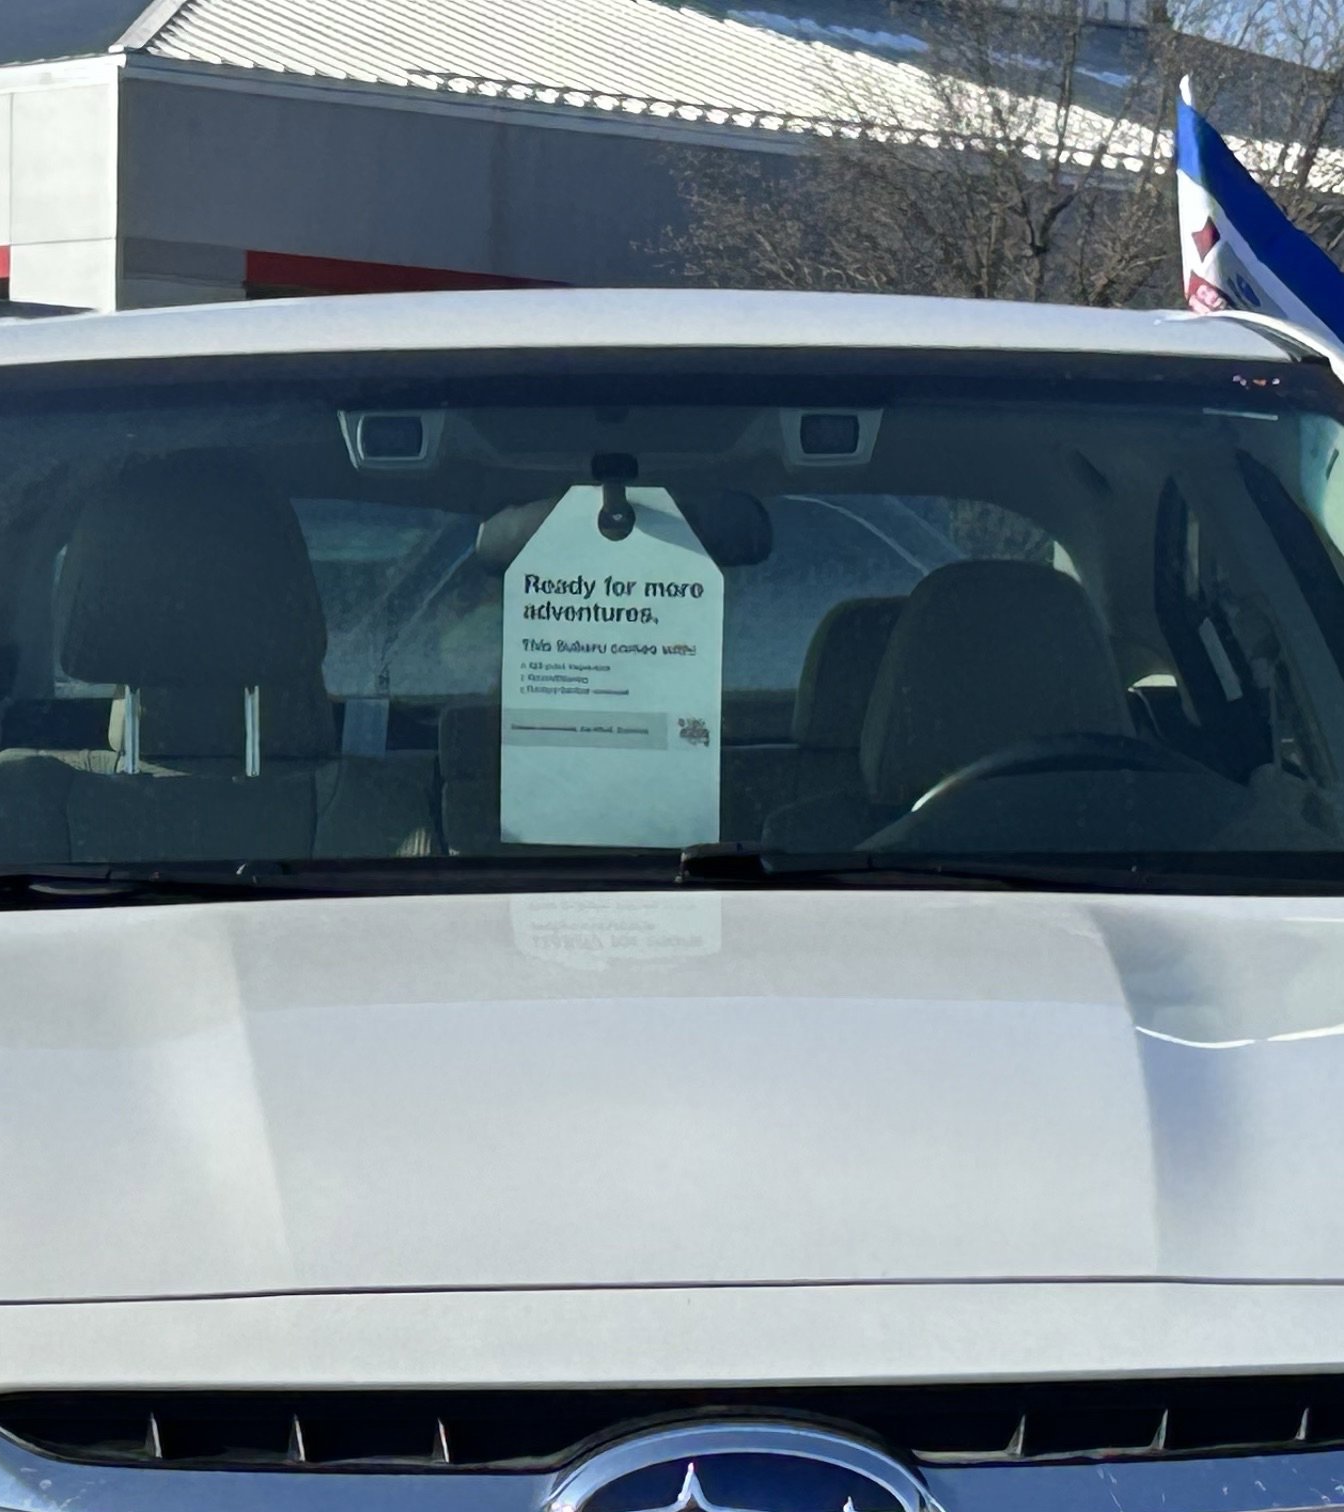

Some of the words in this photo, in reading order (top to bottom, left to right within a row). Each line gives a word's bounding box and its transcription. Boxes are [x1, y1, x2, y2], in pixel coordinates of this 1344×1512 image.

[523, 574, 596, 600] Ready
[604, 575, 637, 597] for
[644, 581, 704, 599] more
